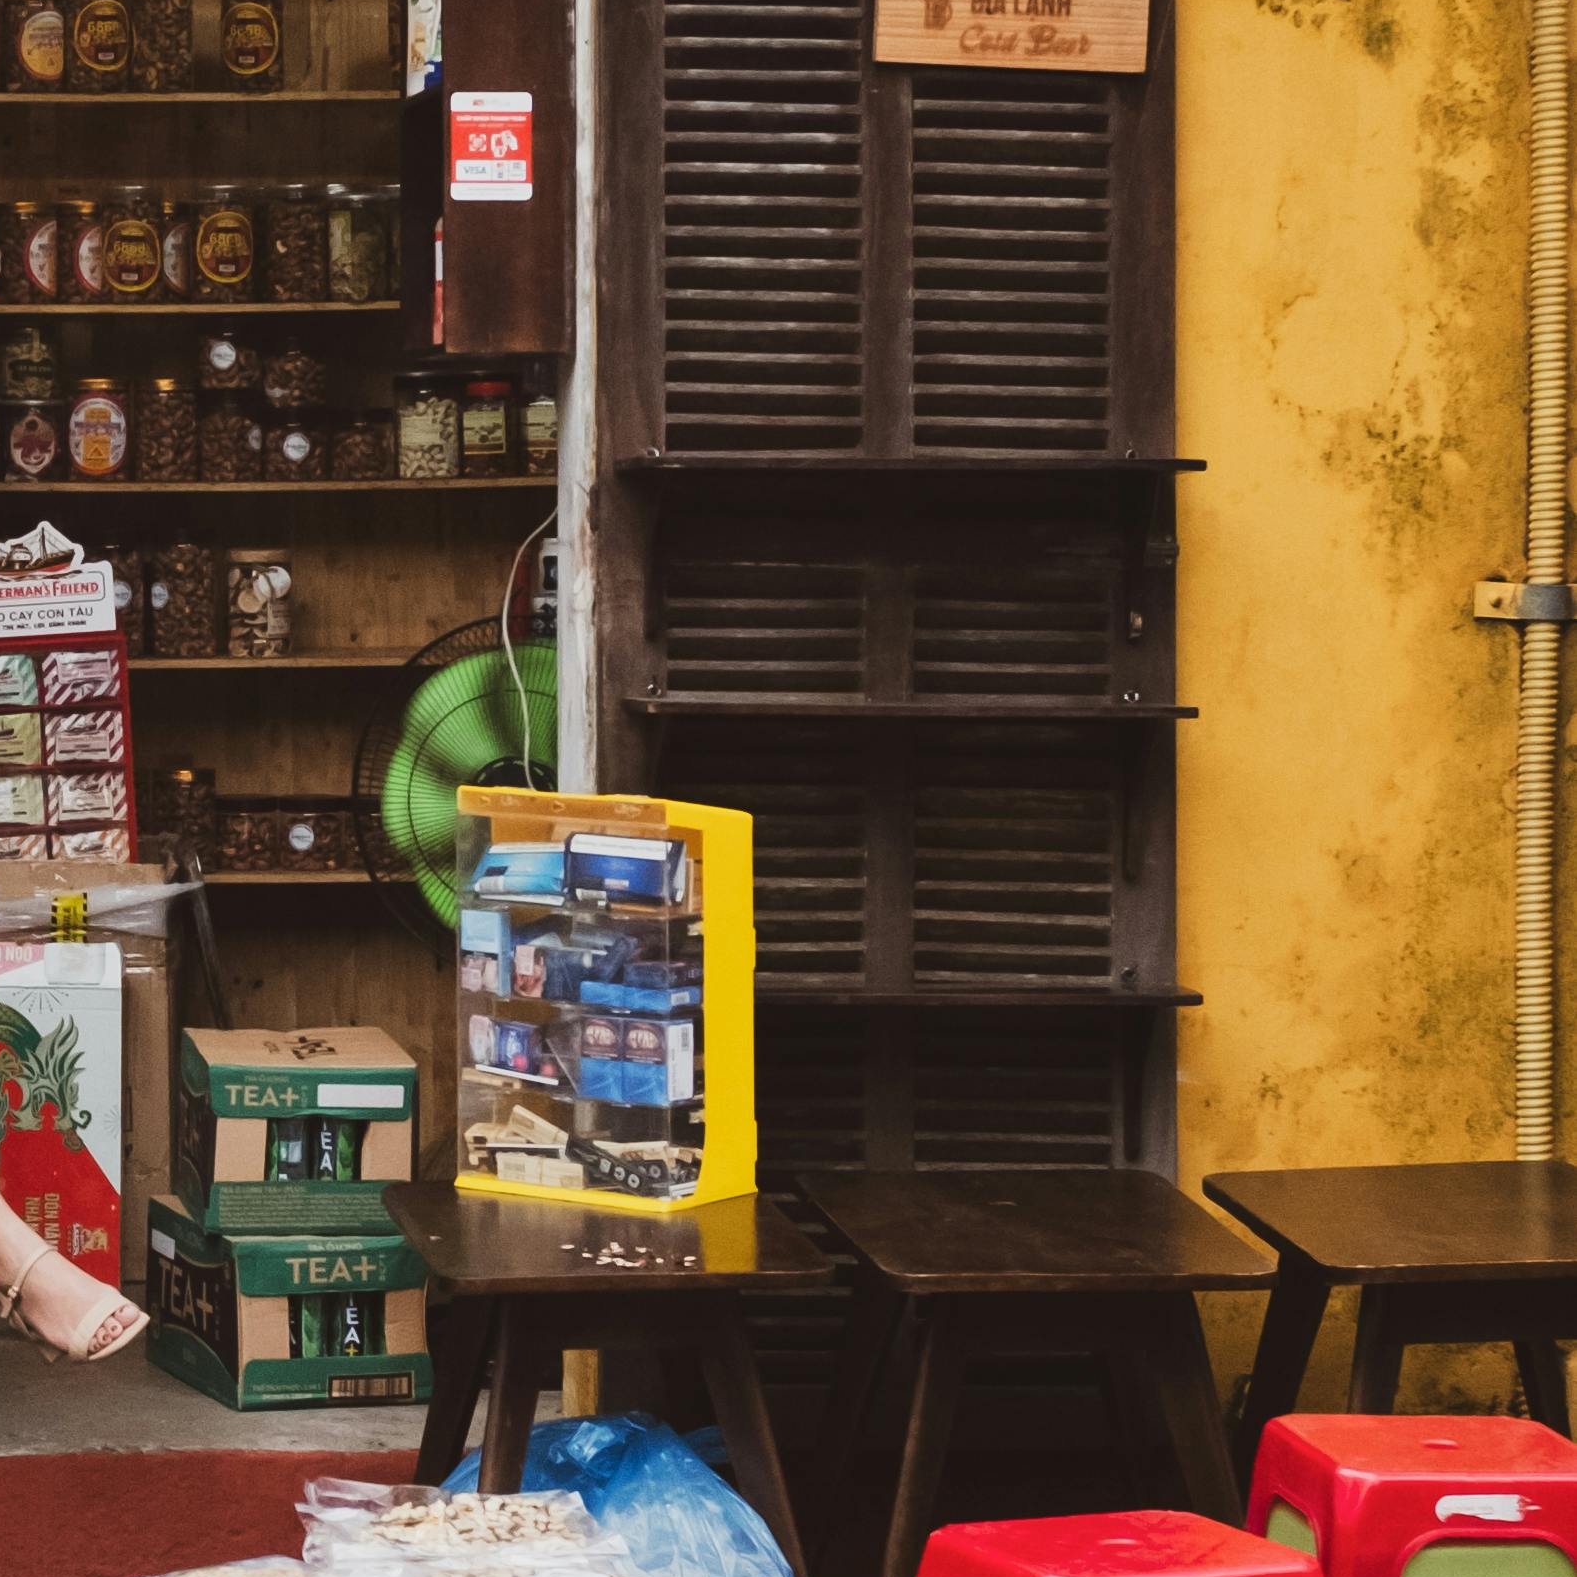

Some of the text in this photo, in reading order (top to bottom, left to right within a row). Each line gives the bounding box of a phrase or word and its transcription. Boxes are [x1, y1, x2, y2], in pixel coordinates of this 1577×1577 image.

[959, 24, 1090, 56] Cold Beer
[53, 580, 99, 597] FRIEND
[9, 610, 34, 622] CAY
[37, 608, 64, 620] CON
[224, 1085, 299, 1108] TEA+
[285, 1255, 377, 1285] TEA+
